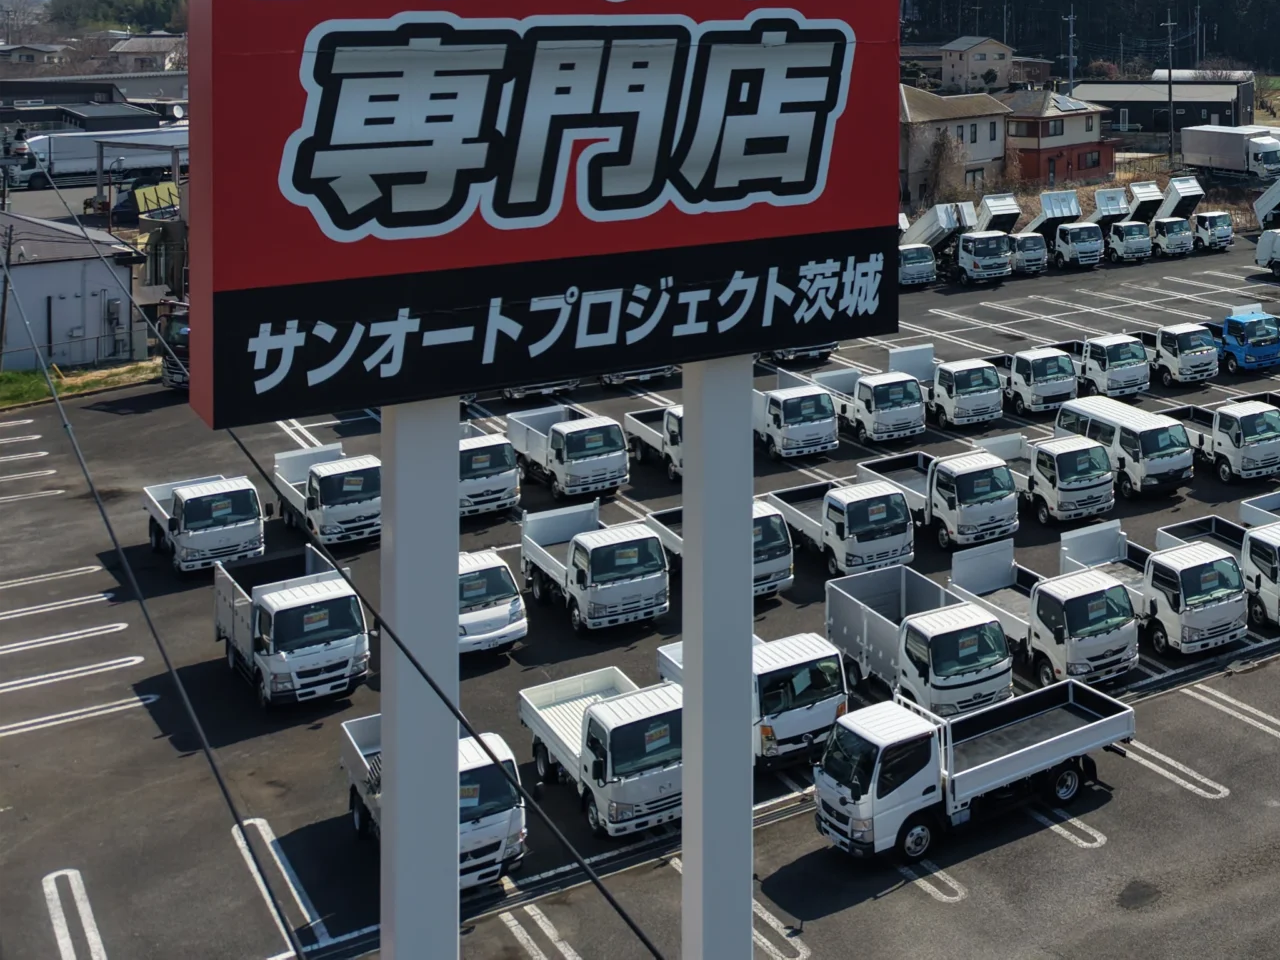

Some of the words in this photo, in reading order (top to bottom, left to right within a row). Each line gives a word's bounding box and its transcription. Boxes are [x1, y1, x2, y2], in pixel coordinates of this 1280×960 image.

[287, 14, 850, 235] 専門店
[248, 252, 884, 394] サンオートプロジェクト茨城
